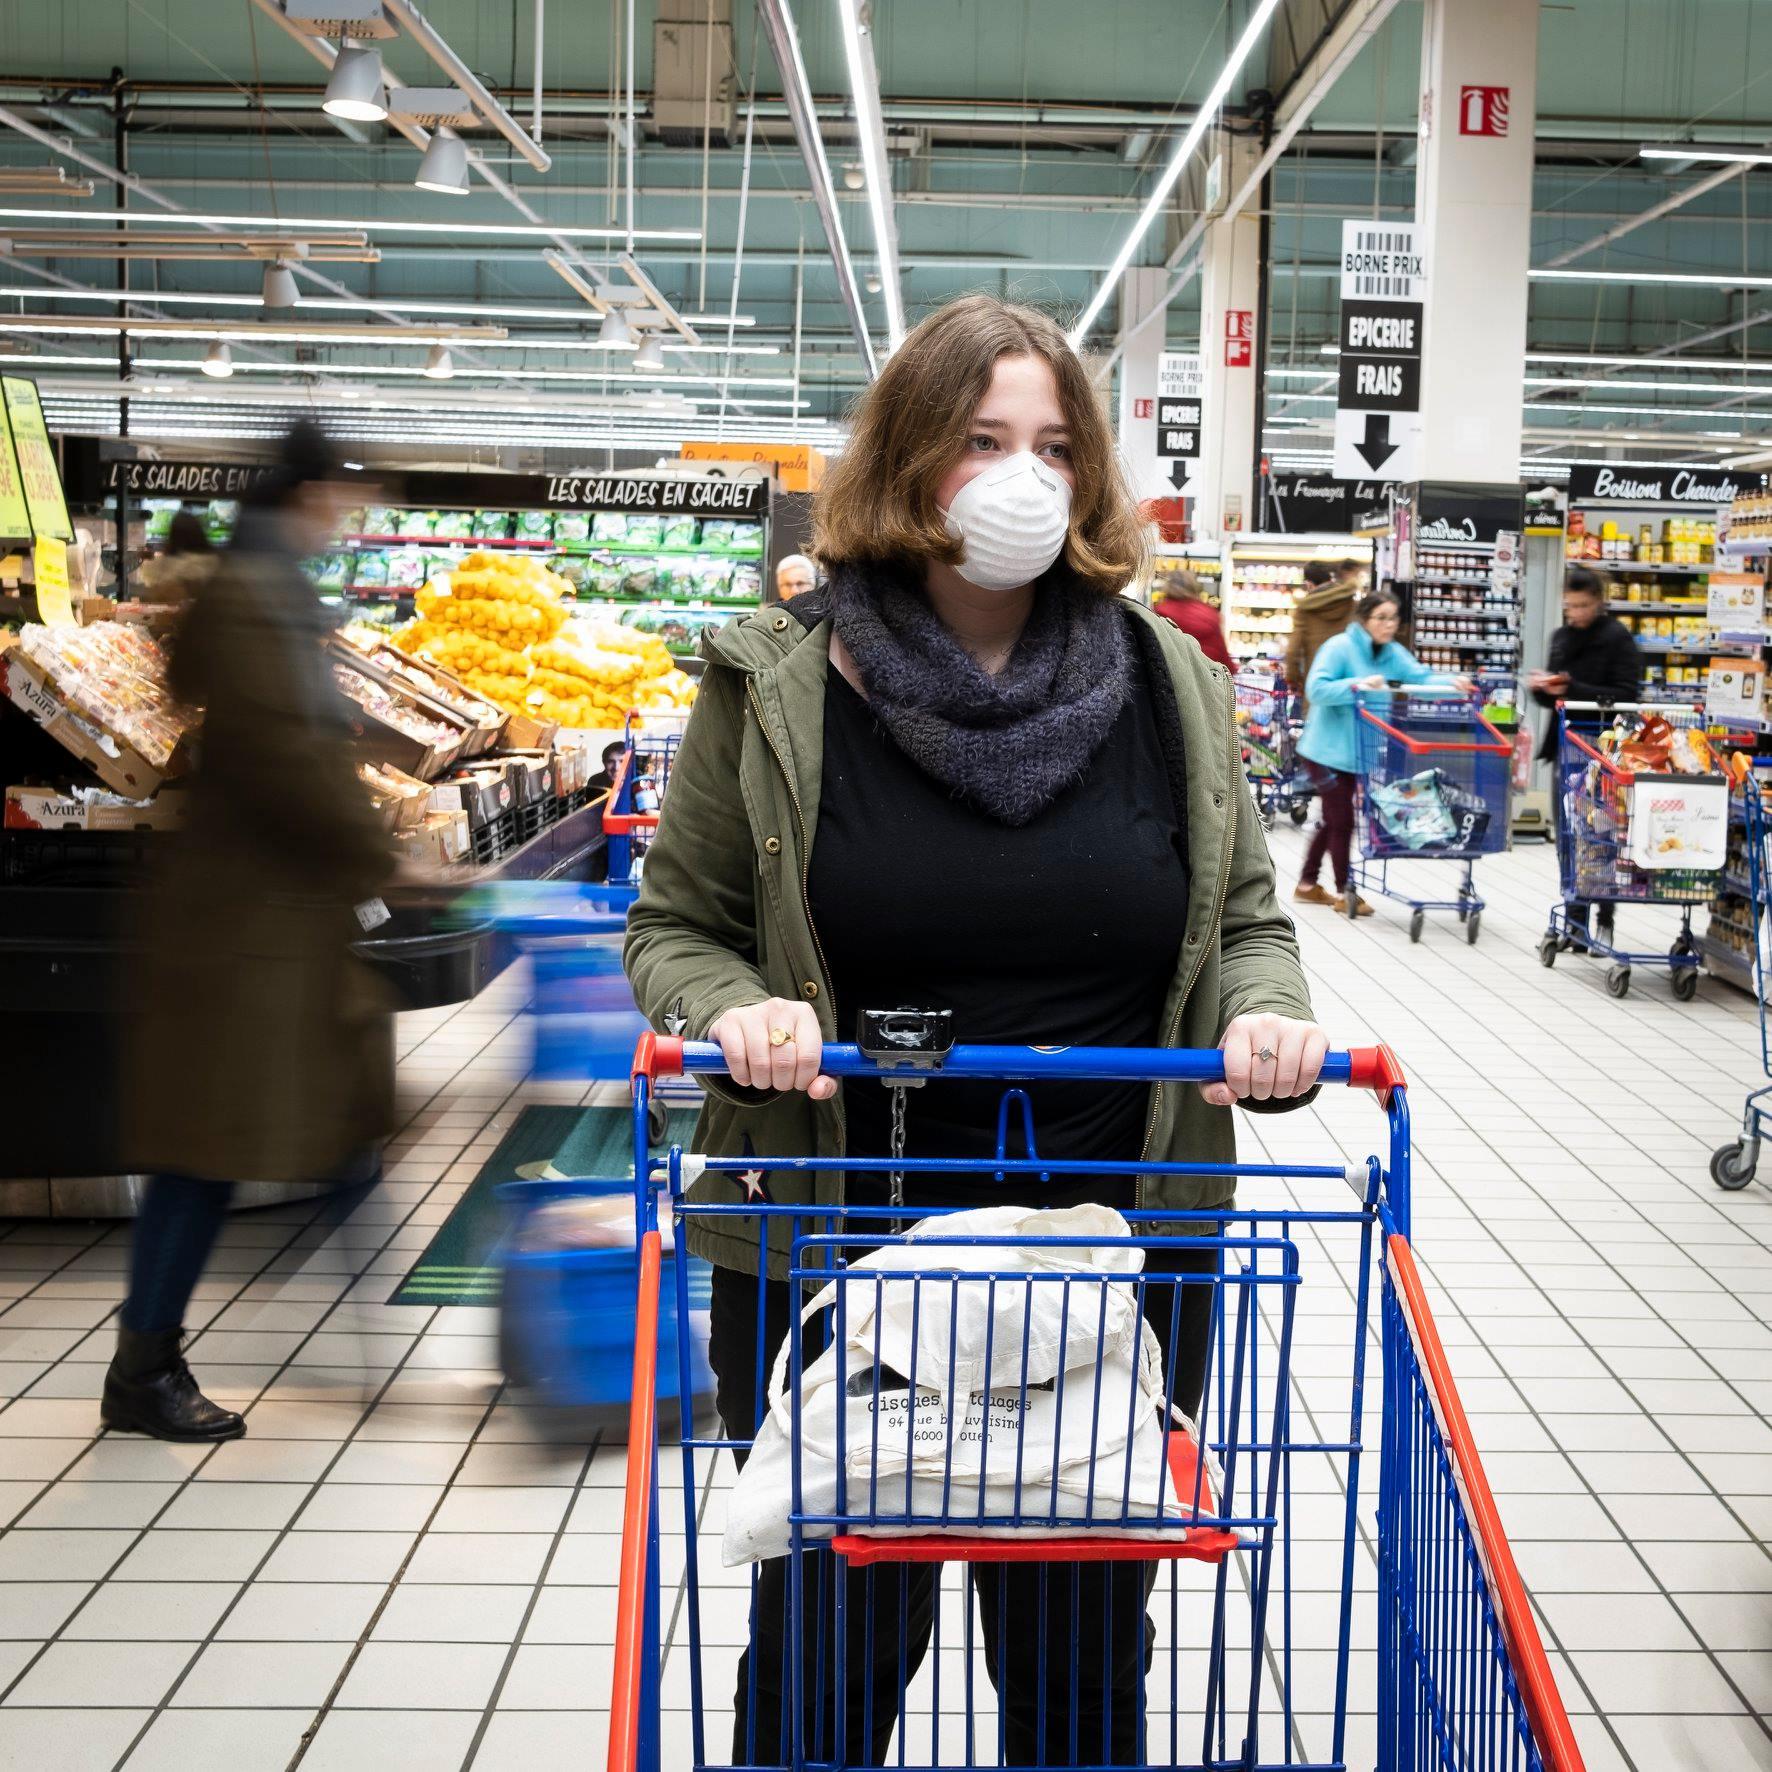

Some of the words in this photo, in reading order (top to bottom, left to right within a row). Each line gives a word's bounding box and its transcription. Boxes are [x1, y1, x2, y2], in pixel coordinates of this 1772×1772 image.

[1346, 254, 1388, 273] BORNE
[1393, 256, 1423, 275] PRIX
[1349, 316, 1415, 349] EPICERIE
[1356, 364, 1403, 396] FRAIS
[1161, 405, 1200, 424] EPICERIE
[1166, 431, 1194, 450] FRAIS
[145, 464, 222, 491] SALADES
[226, 468, 250, 492] EN
[1593, 468, 1662, 500] Boissons
[1670, 470, 1739, 502] Chaudes
[549, 478, 582, 503] LES
[583, 479, 660, 506] SALADES
[662, 481, 687, 507] EN
[689, 481, 758, 508] SACHET
[20, 681, 57, 717] Azura
[42, 801, 86, 817] Azura
[888, 1416, 905, 1428] 94
[910, 1416, 933, 1426] ue
[906, 1430, 943, 1441] 6000
[959, 1430, 994, 1443] ouen
